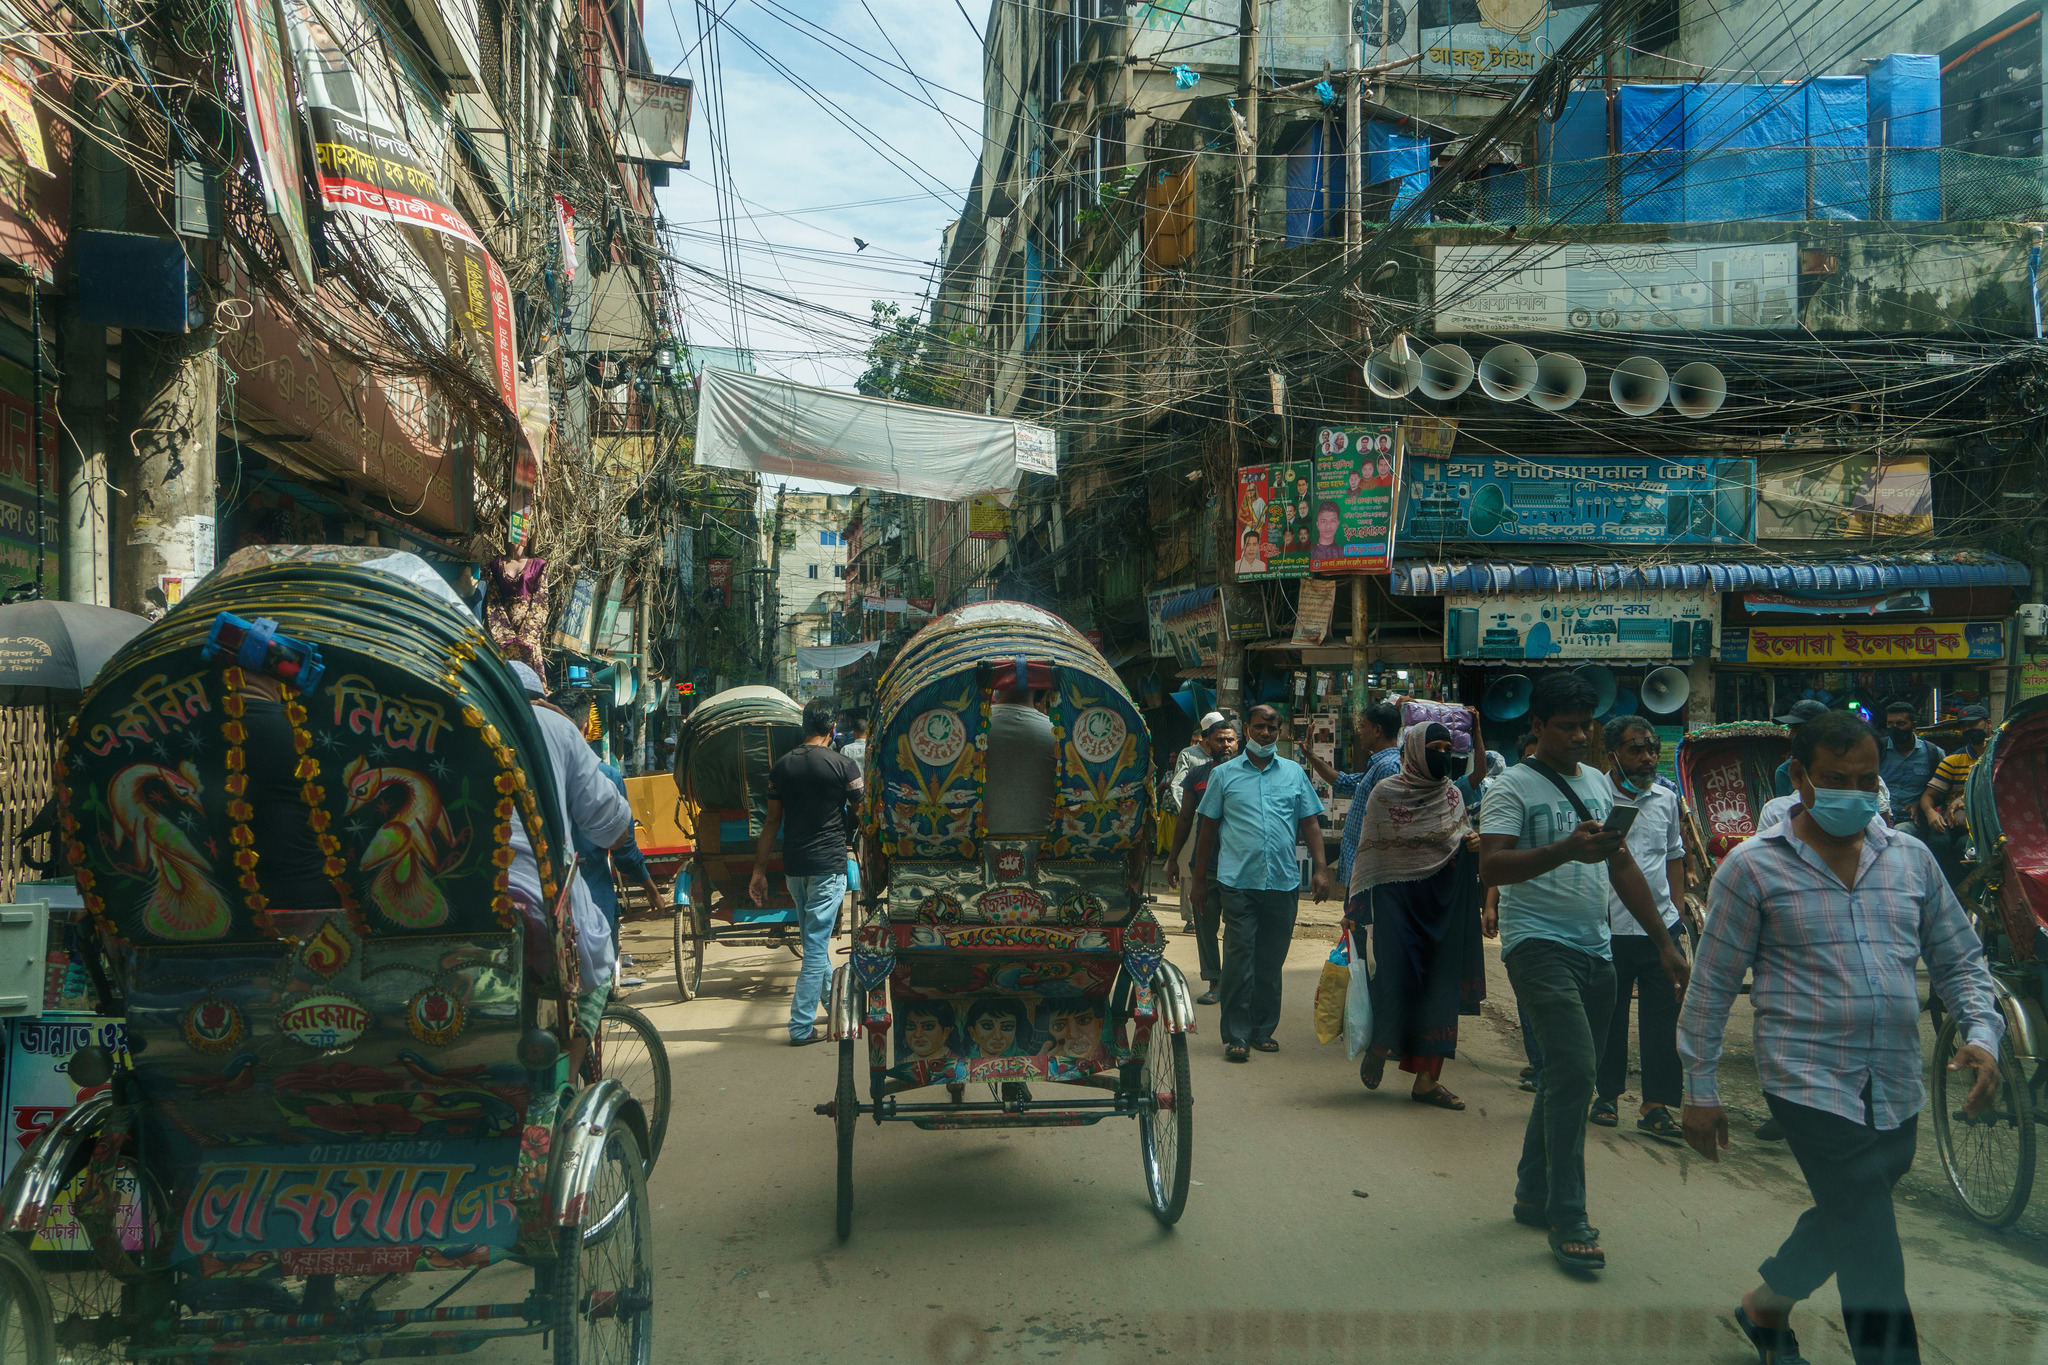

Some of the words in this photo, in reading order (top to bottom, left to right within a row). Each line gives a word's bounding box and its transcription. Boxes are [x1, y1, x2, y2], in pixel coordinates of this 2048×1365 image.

[1428, 47, 1490, 72] আরজু
[1487, 45, 1534, 70] টাইম
[380, 156, 405, 189] হক
[1608, 248, 1668, 270] CORE
[1446, 463, 1485, 479] হুদা
[1494, 462, 1650, 480] ইন্টারন্যাশনাল
[1518, 523, 1596, 536] মাইকসেট
[1601, 522, 1666, 536] বিক্রেতা
[1592, 603, 1651, 616] শো-রুম
[1752, 629, 1836, 658] ইলোরা
[1842, 627, 1961, 657] ইলেকট্রিক
[1702, 759, 1745, 790] কালু
[859, 925, 891, 948] মা
[1128, 921, 1157, 945] মা
[281, 1003, 370, 1032] লোকমান
[20, 1021, 94, 1056] জান্নাত
[304, 1028, 341, 1047] ভাই
[182, 1162, 475, 1253] লোকমান
[452, 1164, 517, 1232] ভাই
[38, 1224, 81, 1241] ব্যাটারী
